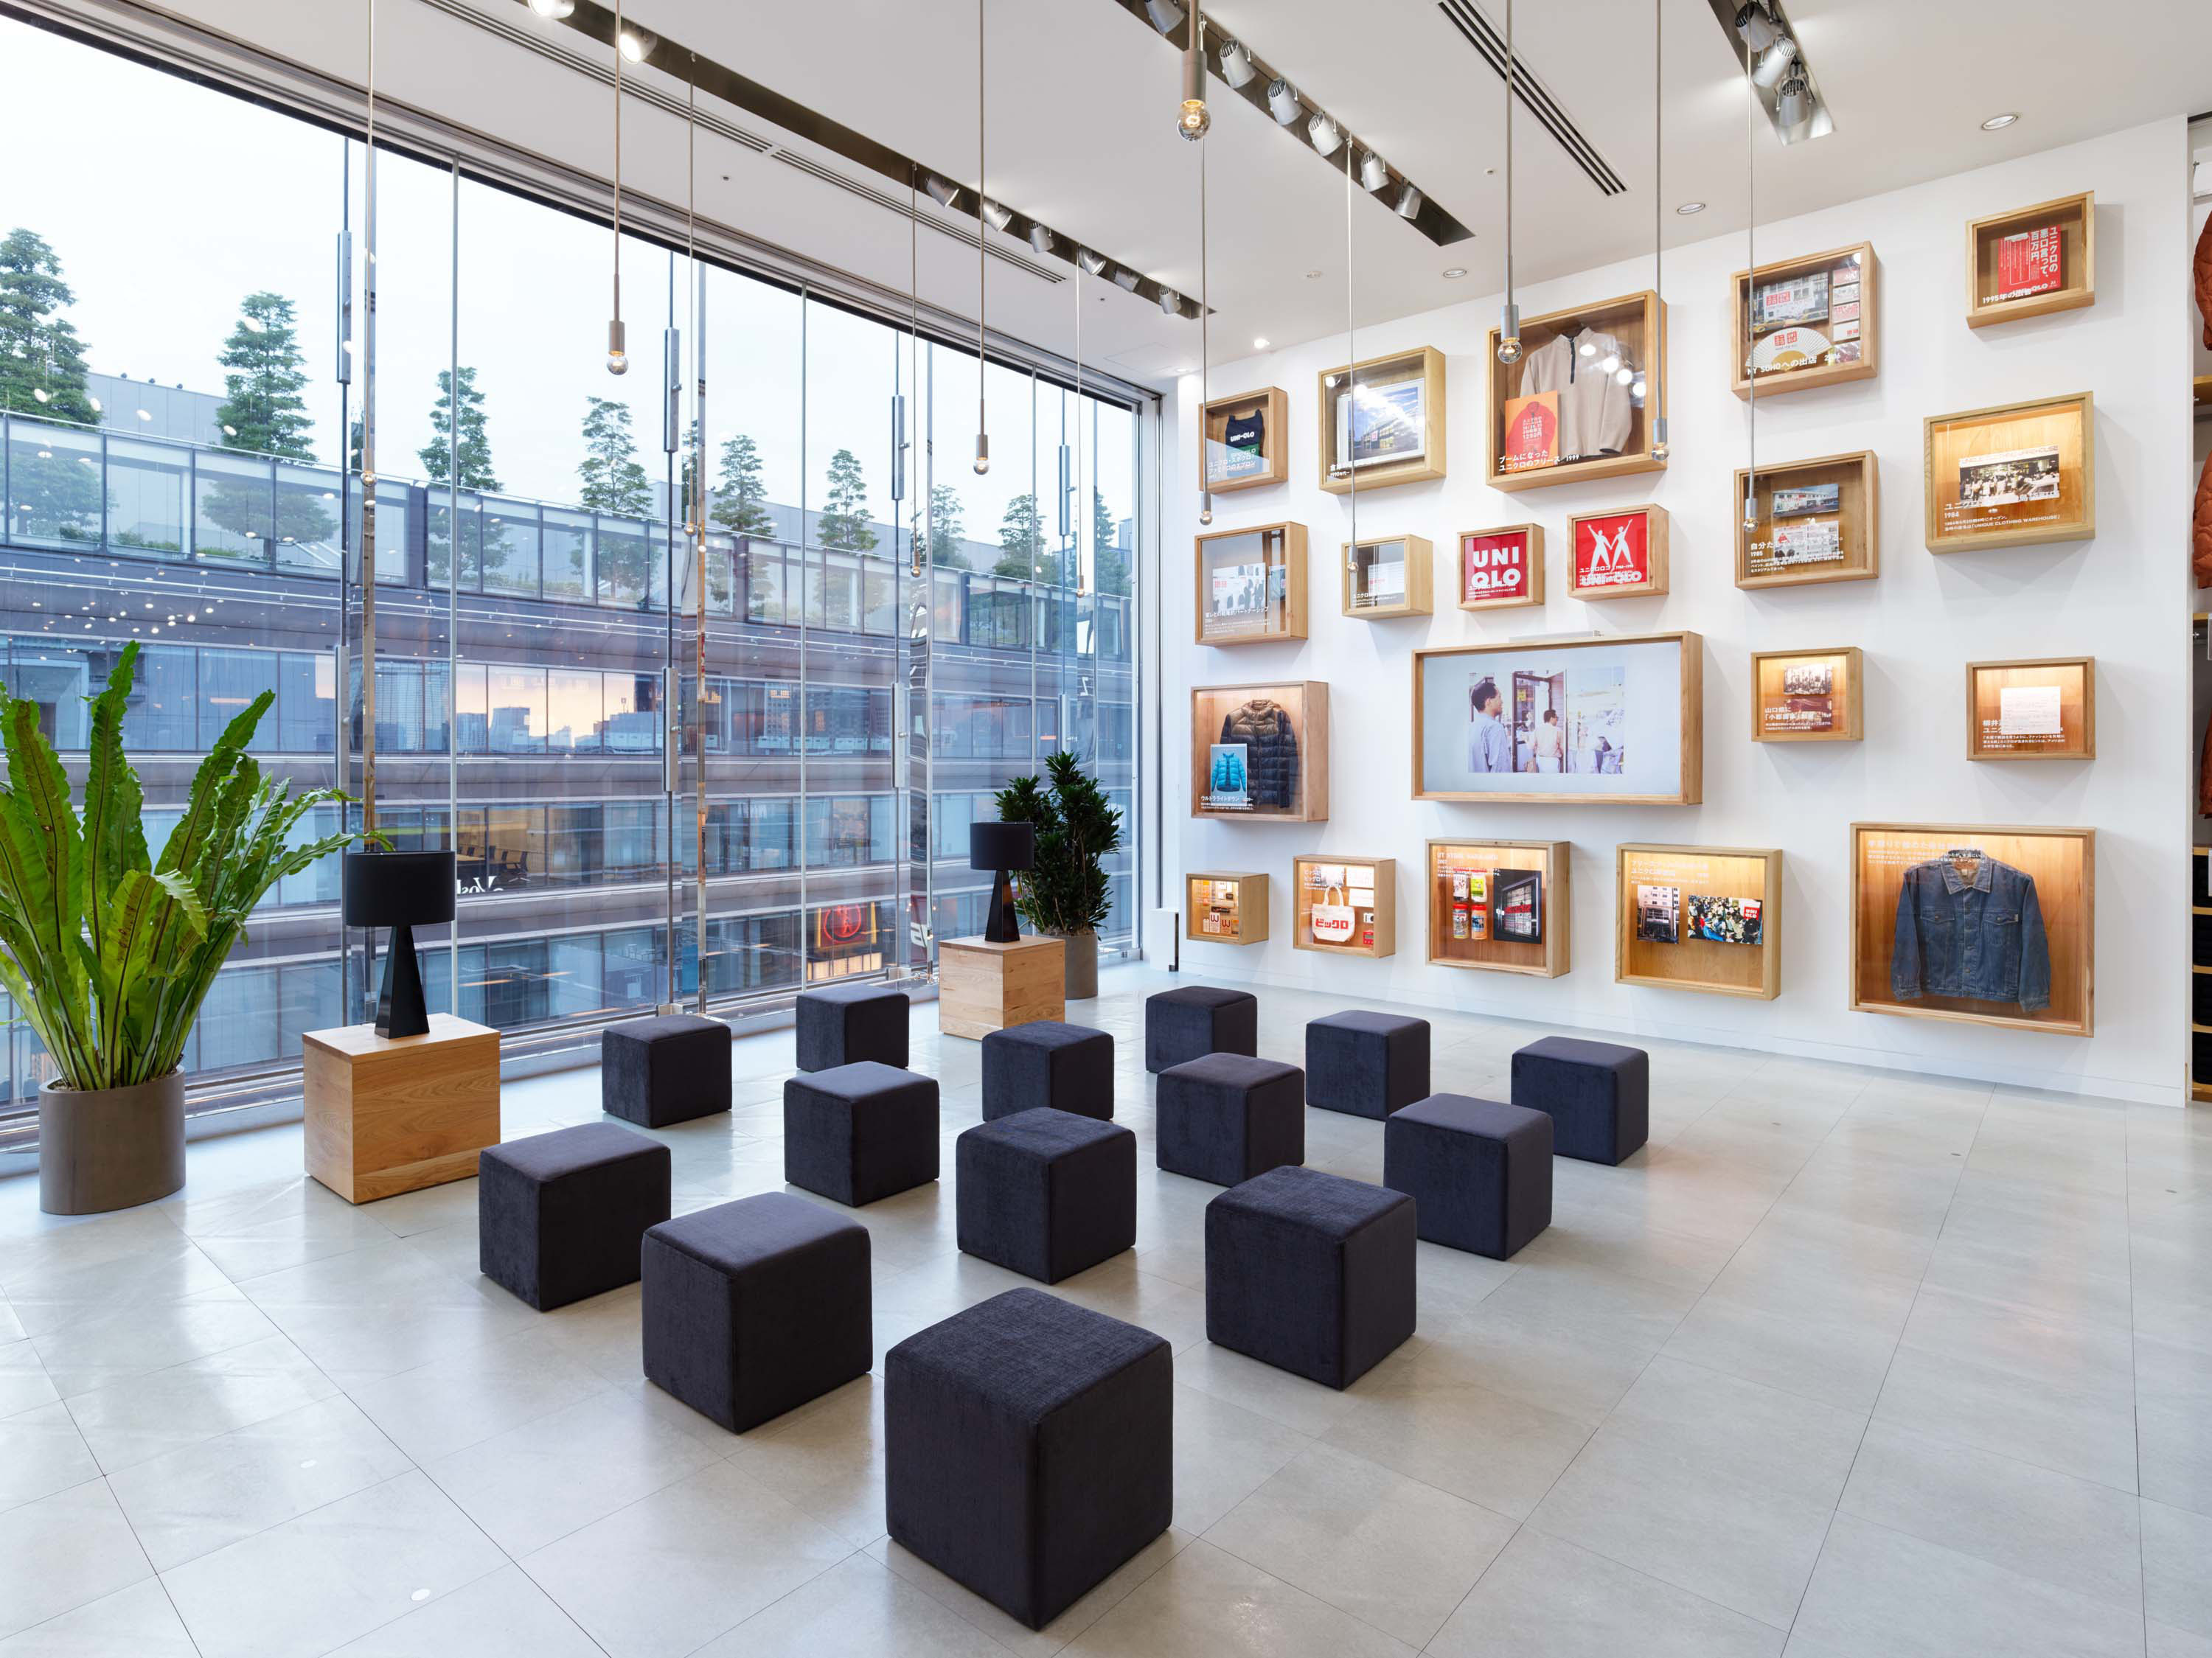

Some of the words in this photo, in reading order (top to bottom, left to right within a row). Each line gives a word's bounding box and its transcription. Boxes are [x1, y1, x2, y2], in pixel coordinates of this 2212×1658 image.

[2031, 230, 2039, 262] 百万円
[2050, 226, 2058, 272] ユニクロの
[1499, 450, 1548, 464] ブームになった
[1499, 456, 1561, 472] ユニクロのフリース
[1473, 546, 1519, 568] UNI
[1472, 568, 1521, 589] QLO
[1315, 918, 1349, 930] ビックロ
